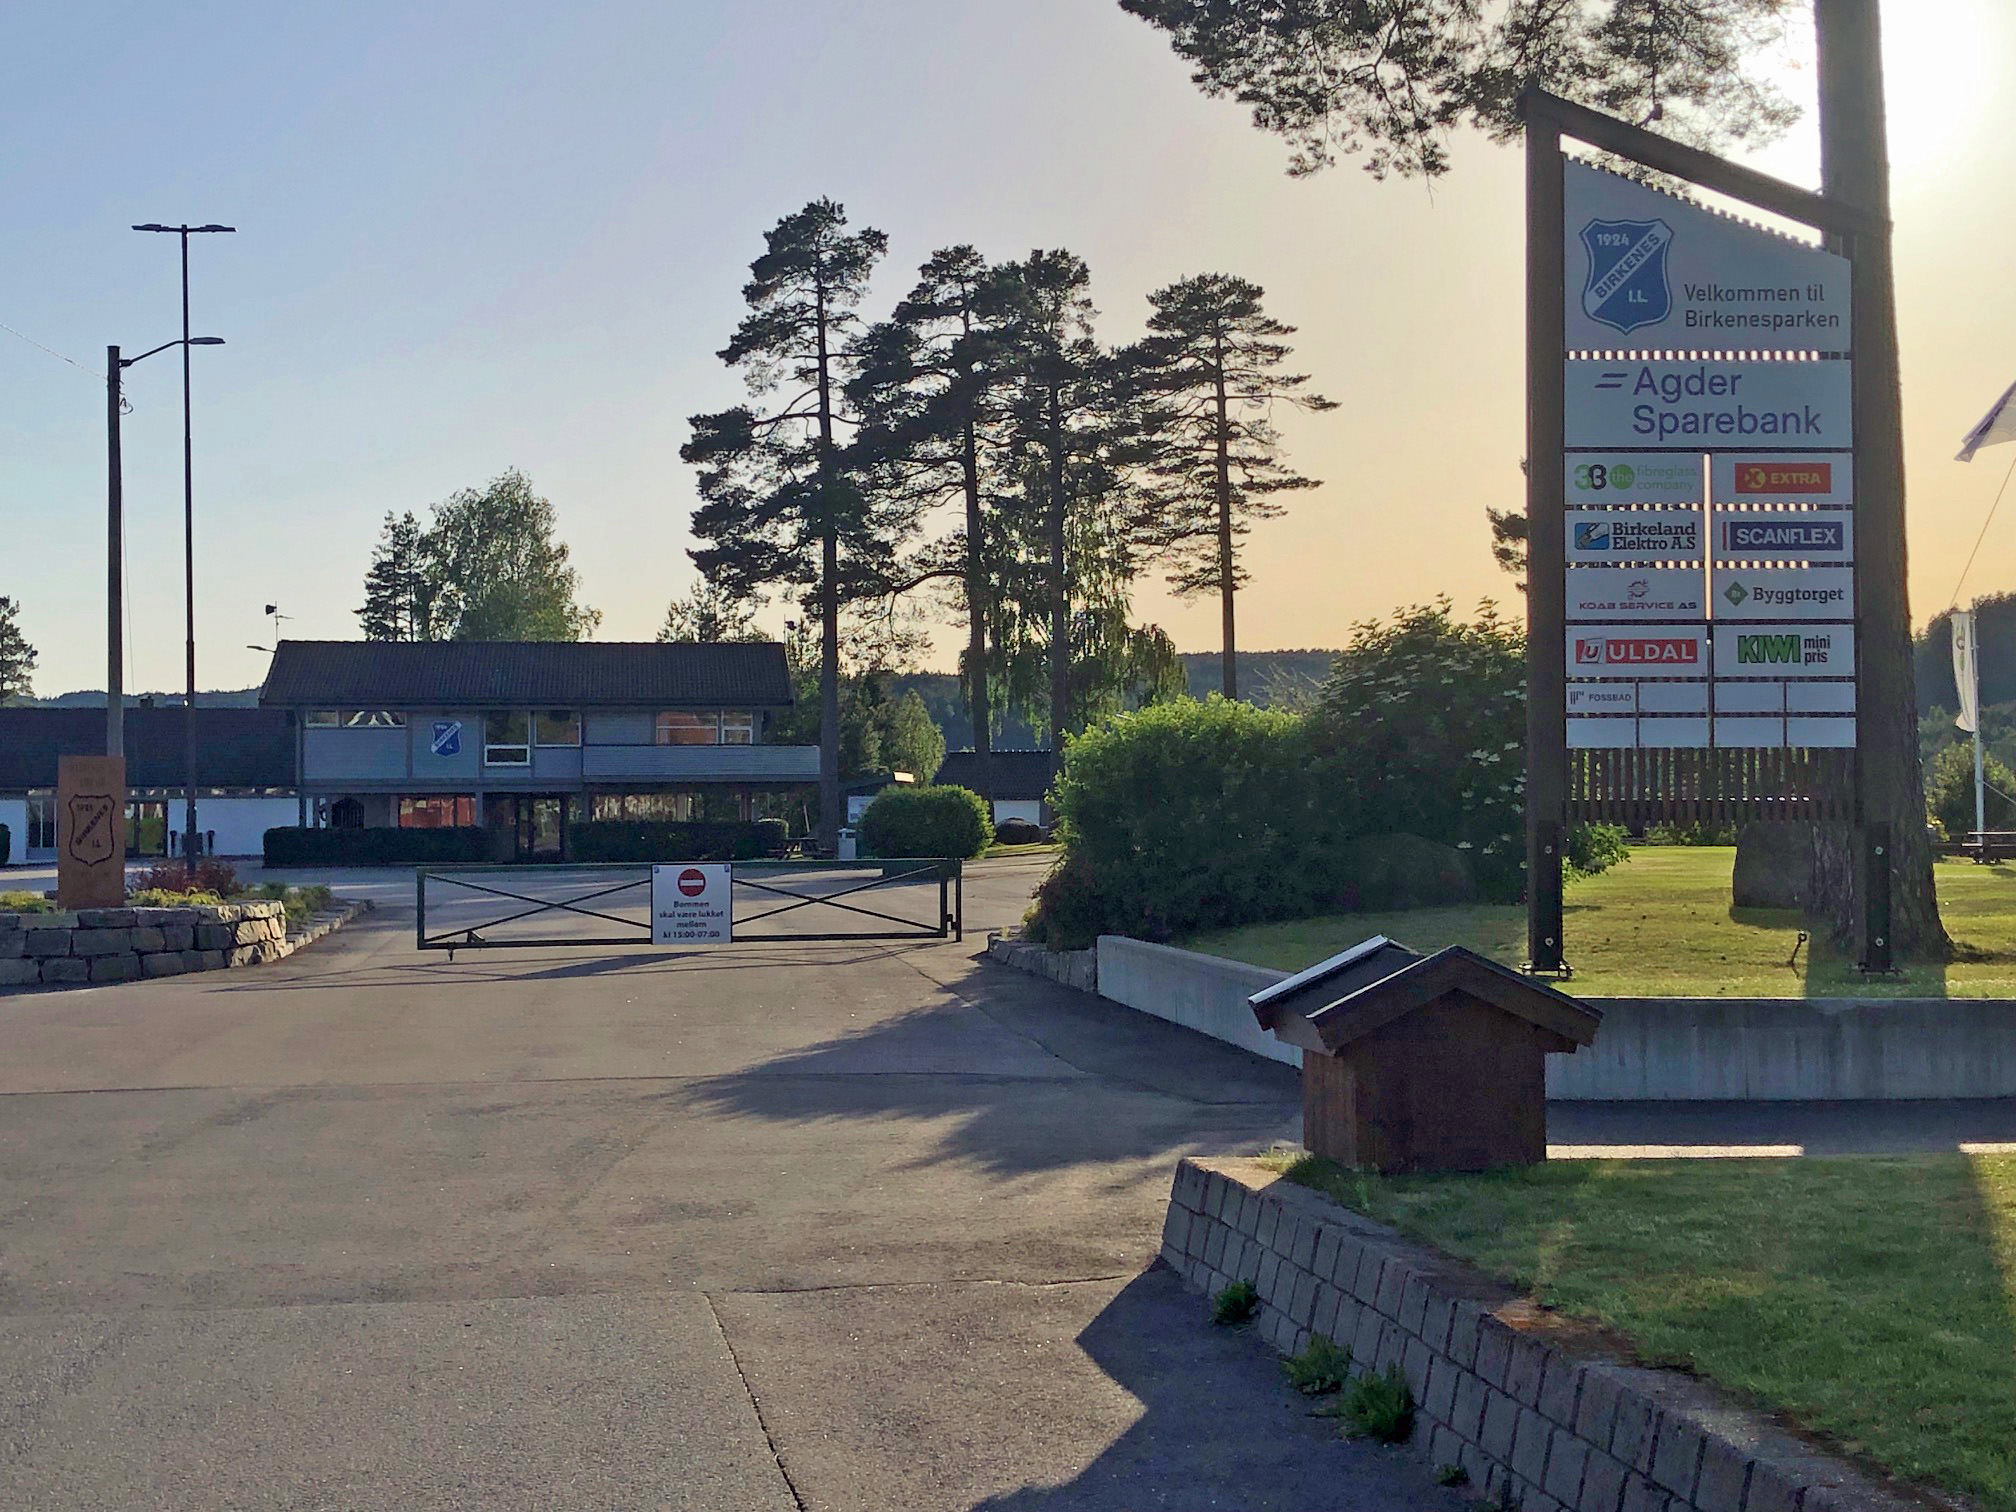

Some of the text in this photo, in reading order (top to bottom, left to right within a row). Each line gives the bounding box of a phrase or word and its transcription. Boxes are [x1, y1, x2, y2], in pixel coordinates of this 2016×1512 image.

[1597, 233, 1629, 246] 1924
[1594, 232, 1661, 299] BIRKENES
[1684, 284, 1825, 302] Velkommen til
[1685, 310, 1839, 331] Birkenesparken
[1633, 367, 1742, 403] Agder
[1633, 405, 1822, 441] Sparebank
[1611, 472, 1632, 482] the
[1637, 464, 1697, 479] fibreglass
[1771, 472, 1821, 484] EXTRA
[1637, 481, 1694, 492] company
[1612, 522, 1696, 536] Birkeland
[1736, 528, 1836, 544] SCANFLEX
[1612, 537, 1668, 550] Elektro
[1753, 587, 1844, 604] Byggtorget
[1579, 602, 1697, 610] KOAB SERVICE AS
[1737, 635, 1801, 663] KIWI
[1804, 635, 1831, 649] mini
[1608, 644, 1695, 660] ULDAL
[1804, 651, 1828, 666] pris
[1589, 694, 1632, 702] FOSSBAD
